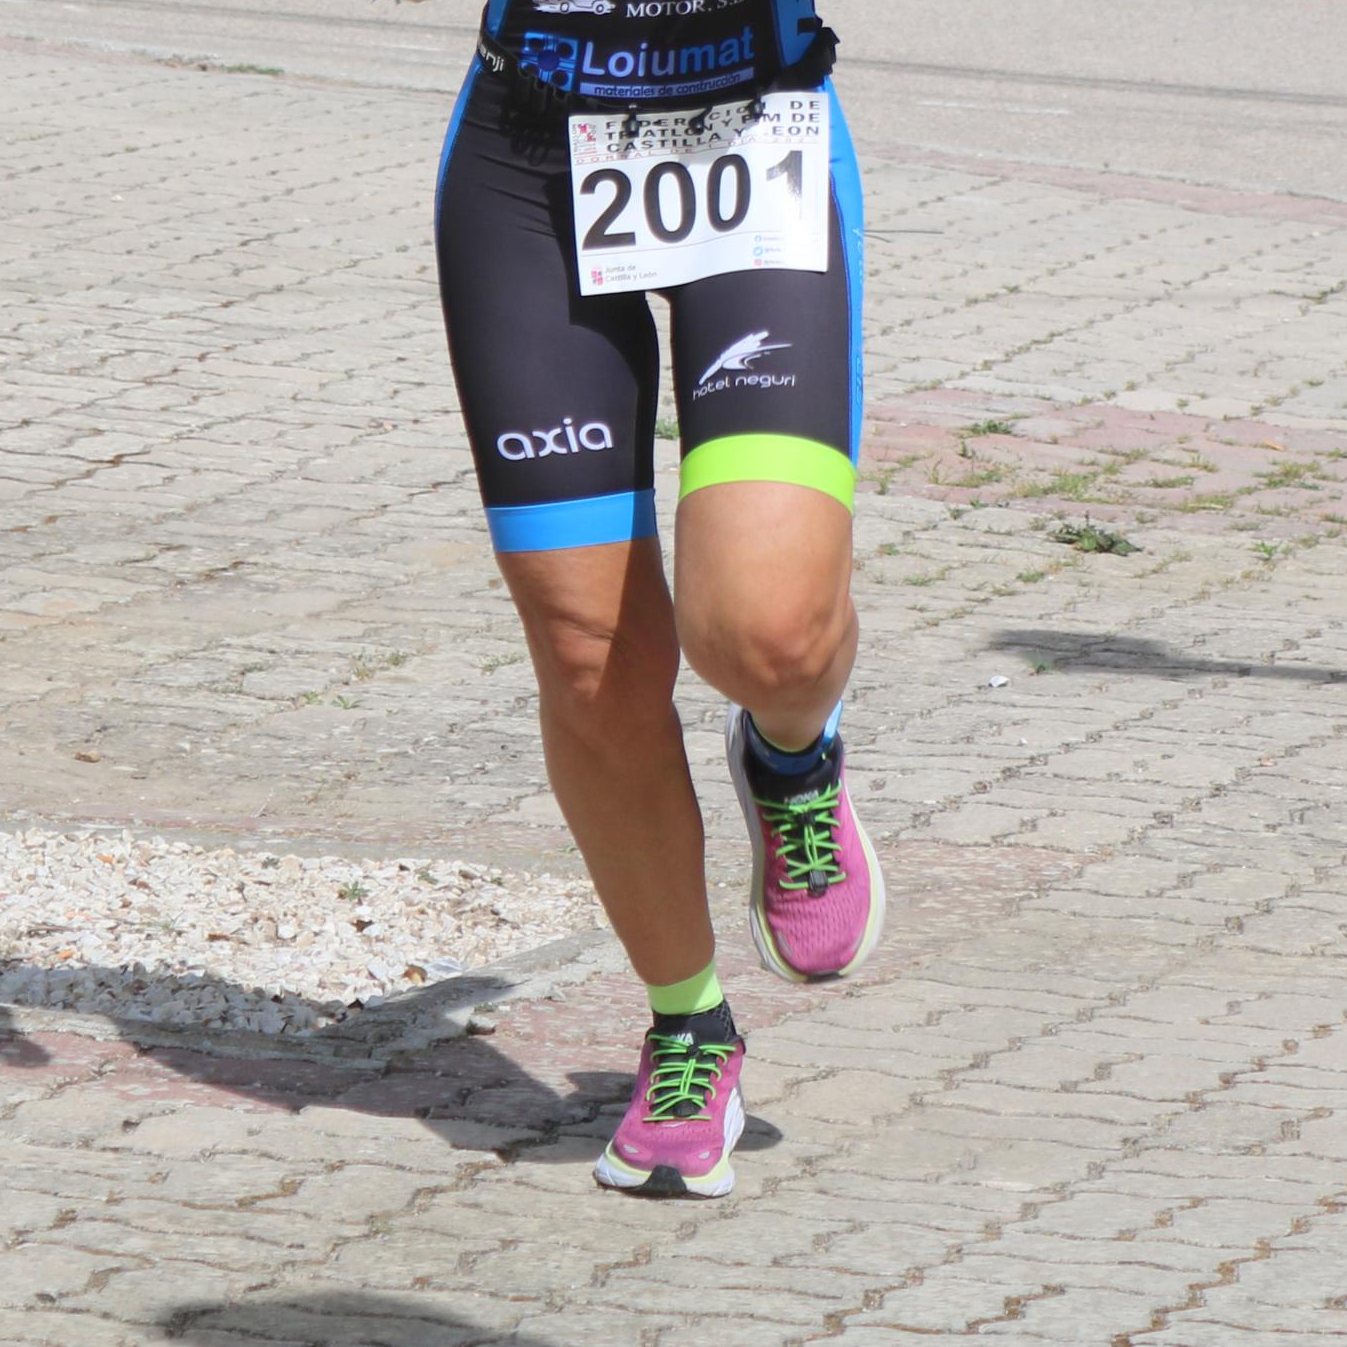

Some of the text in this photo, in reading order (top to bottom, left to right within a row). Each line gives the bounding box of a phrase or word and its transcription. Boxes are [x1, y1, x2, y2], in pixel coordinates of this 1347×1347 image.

[582, 26, 755, 78] Loiumat
[593, 72, 741, 98] materiales de construcción
[606, 132, 724, 153] CASTILLA
[579, 150, 803, 251] 2001
[692, 370, 796, 401] hotel neguri
[496, 417, 614, 462] axia
